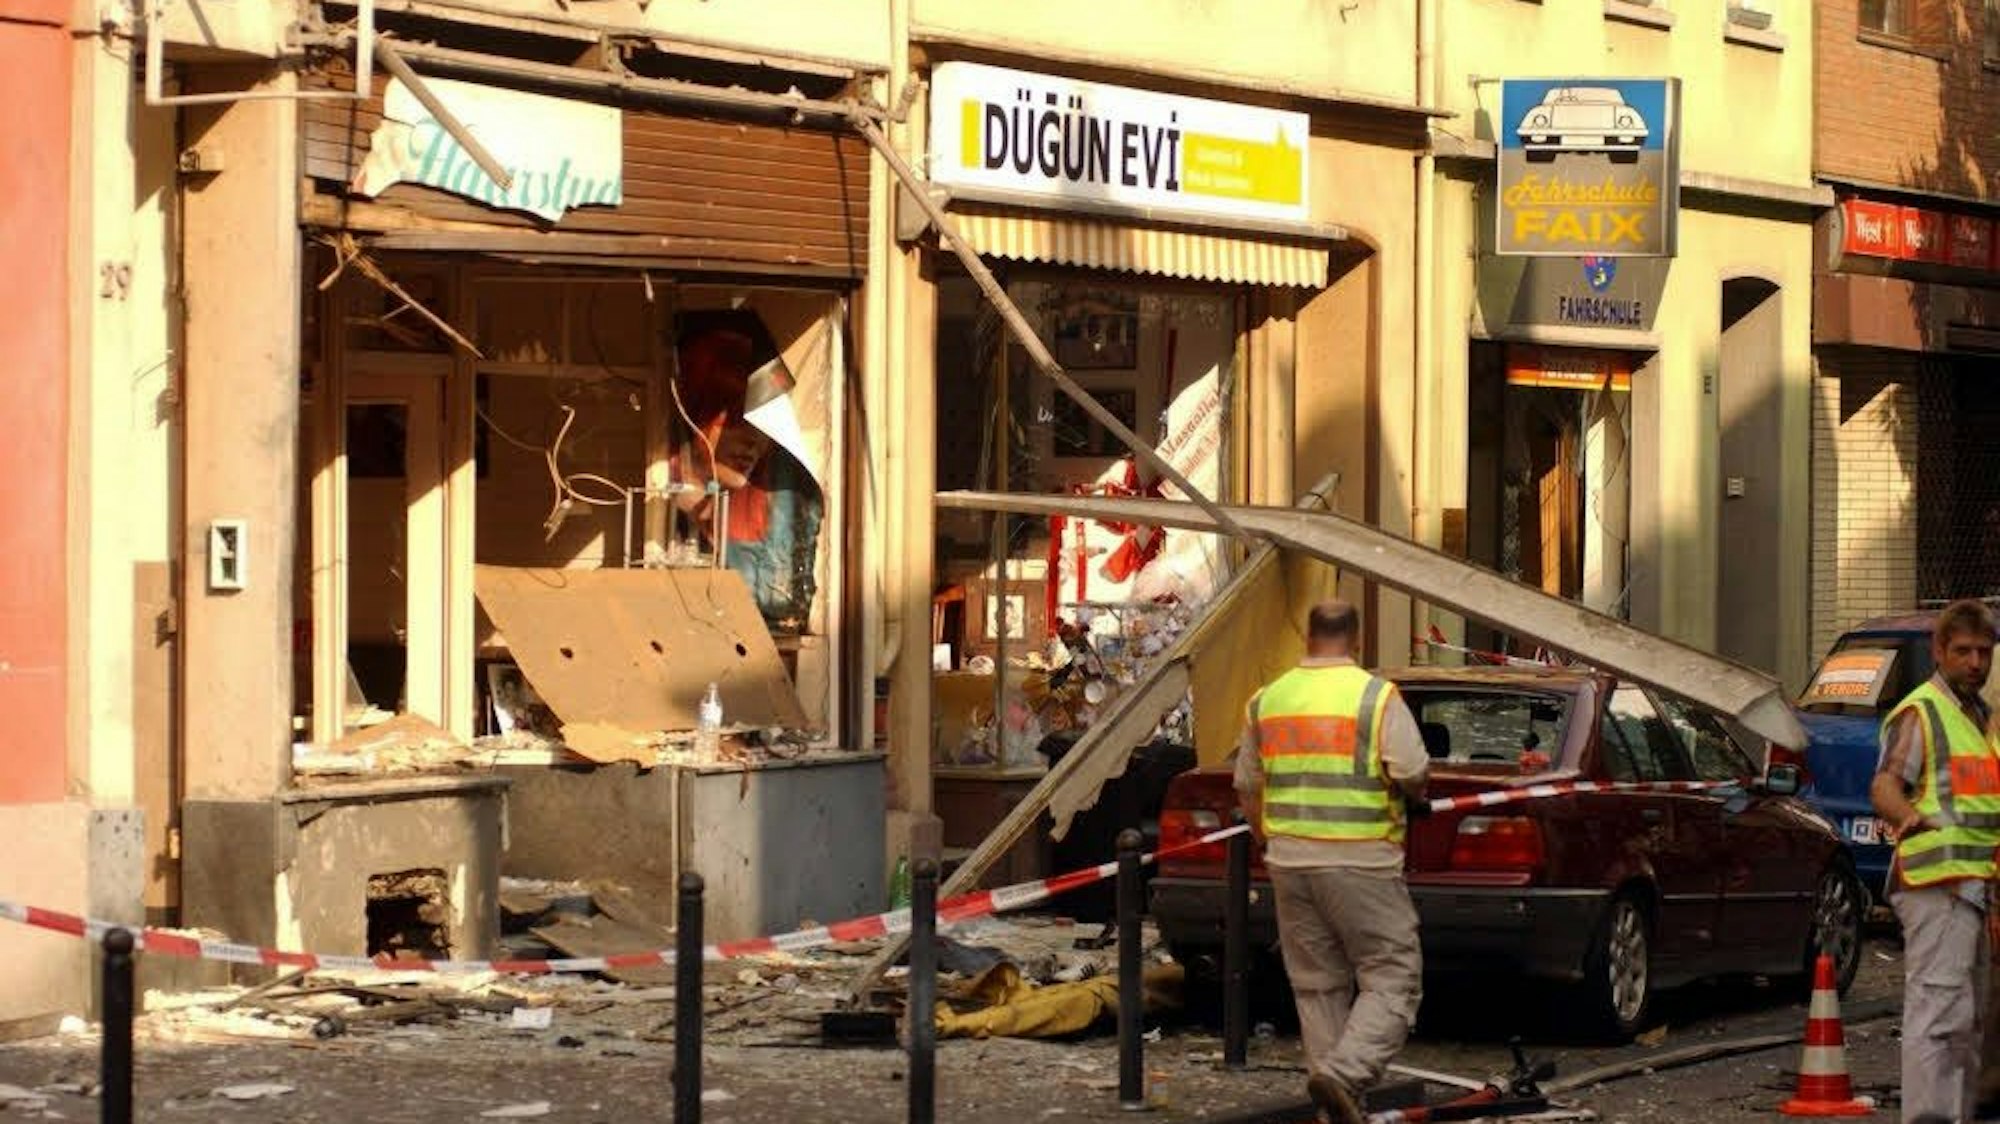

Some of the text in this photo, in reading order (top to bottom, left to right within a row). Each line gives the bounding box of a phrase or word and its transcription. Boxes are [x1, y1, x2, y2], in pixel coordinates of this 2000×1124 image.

[1121, 111, 1180, 192] EVİ
[1503, 172, 1658, 208] Fahrschule
[1513, 210, 1645, 244] FAIX
[100, 260, 133, 302] 29
[1559, 296, 1641, 324] FAHRSCHULE
